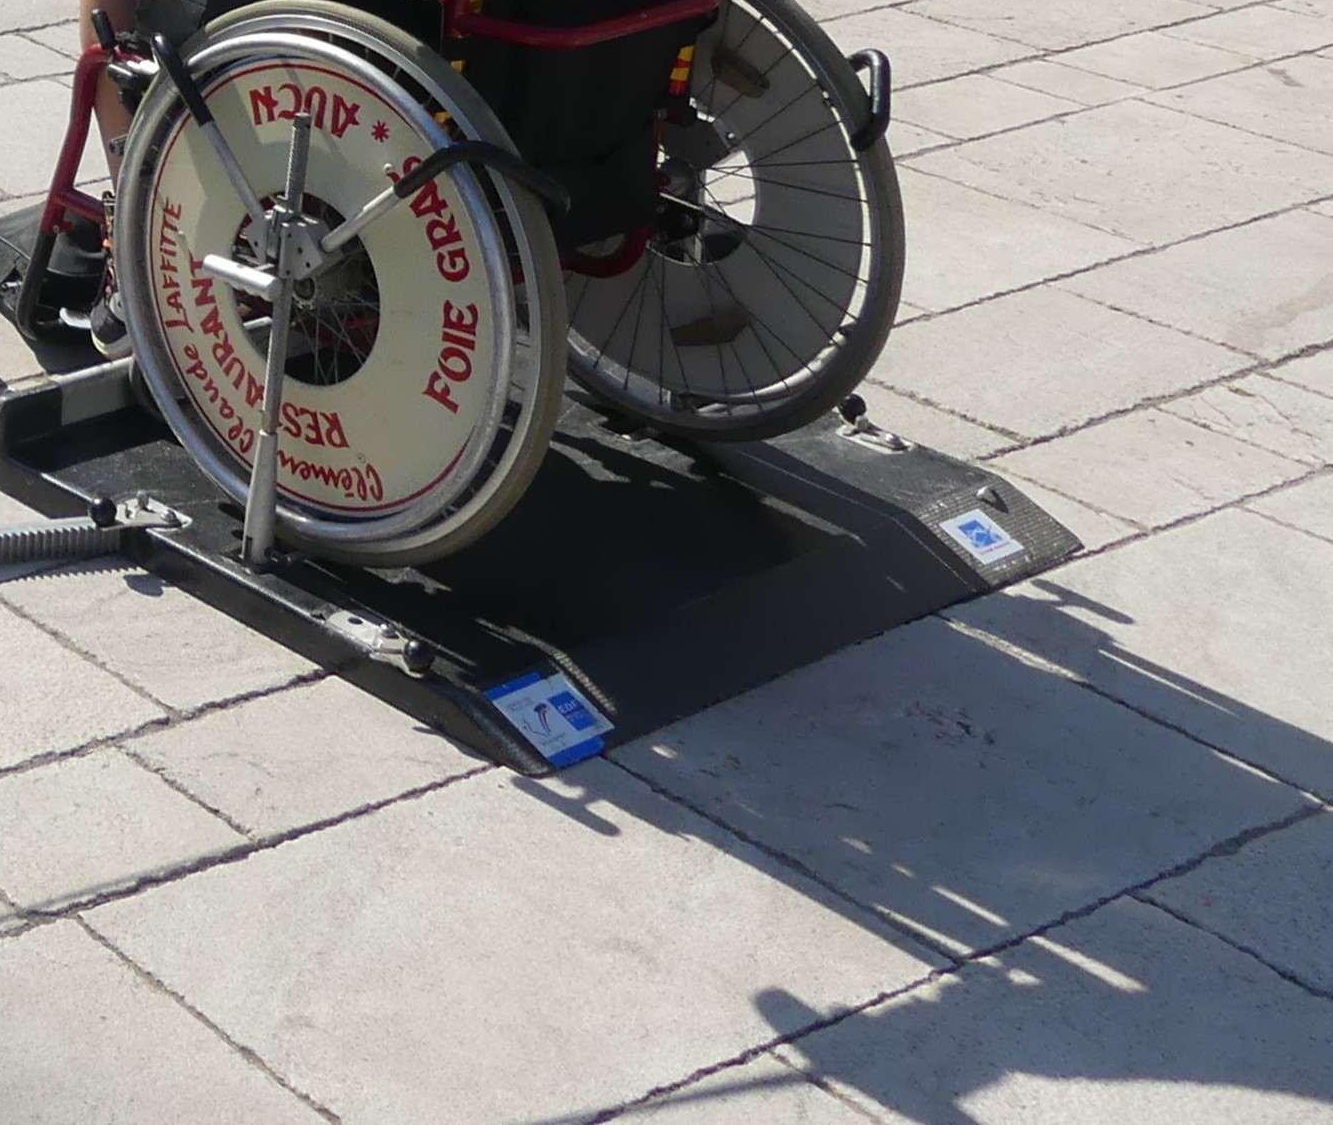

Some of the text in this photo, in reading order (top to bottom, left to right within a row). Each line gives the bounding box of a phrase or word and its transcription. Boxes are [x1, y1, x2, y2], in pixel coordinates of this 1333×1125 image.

[249, 82, 361, 140] AUCH
[189, 248, 350, 449] RESAURANT
[421, 299, 479, 415] FOIE
